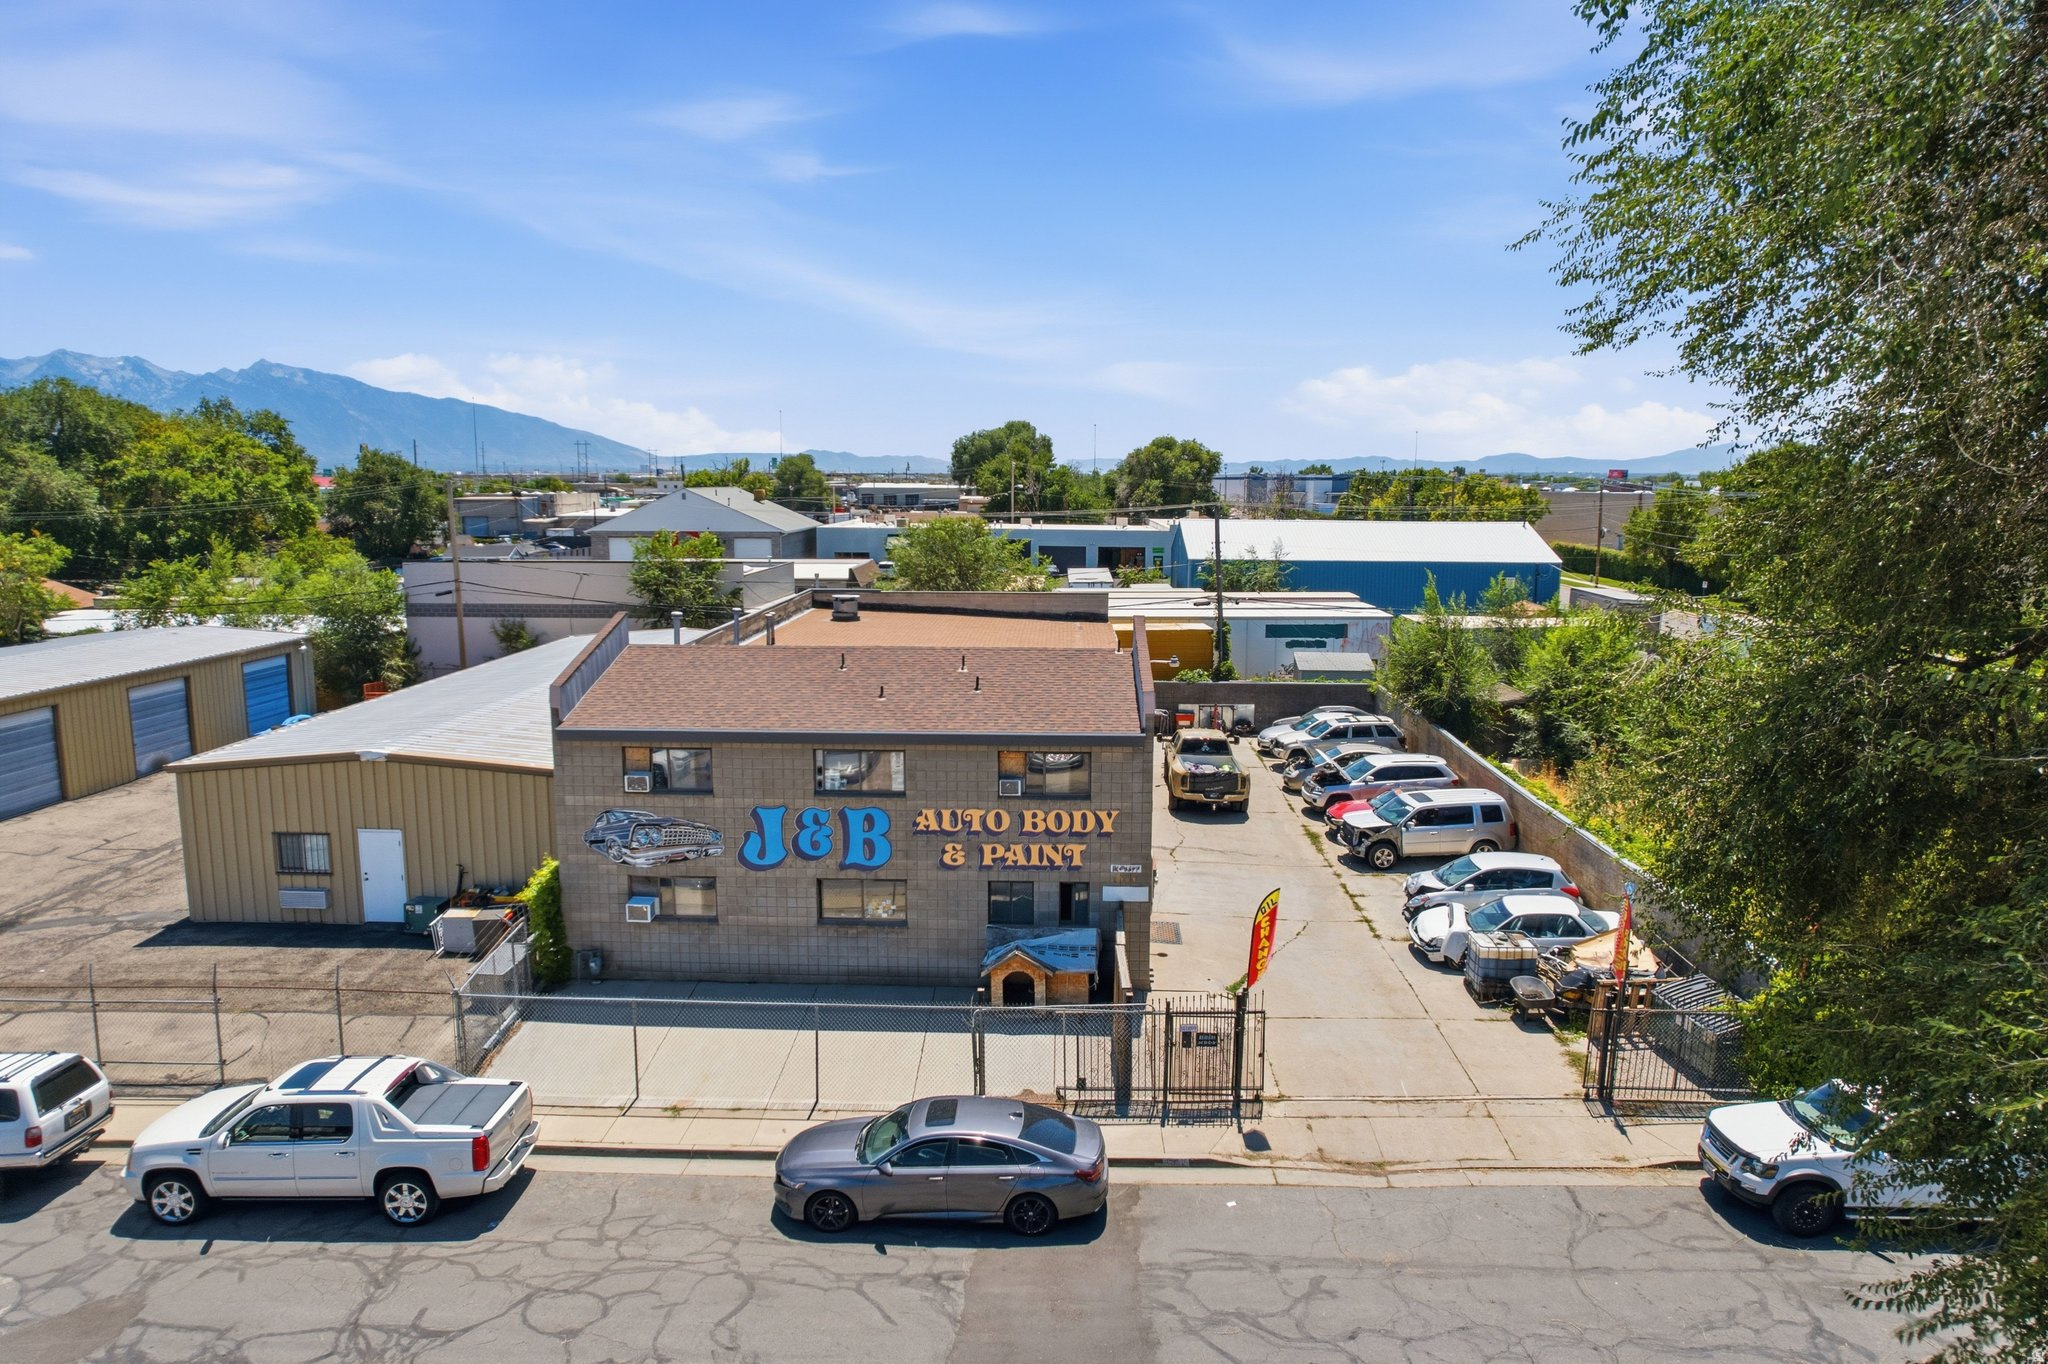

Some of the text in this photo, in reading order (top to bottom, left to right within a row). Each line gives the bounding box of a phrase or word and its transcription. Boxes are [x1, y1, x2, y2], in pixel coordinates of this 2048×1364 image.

[913, 808, 1120, 837] AUTO BODY
[939, 842, 1088, 871] & PAINT
[1260, 898, 1277, 914] OIL
